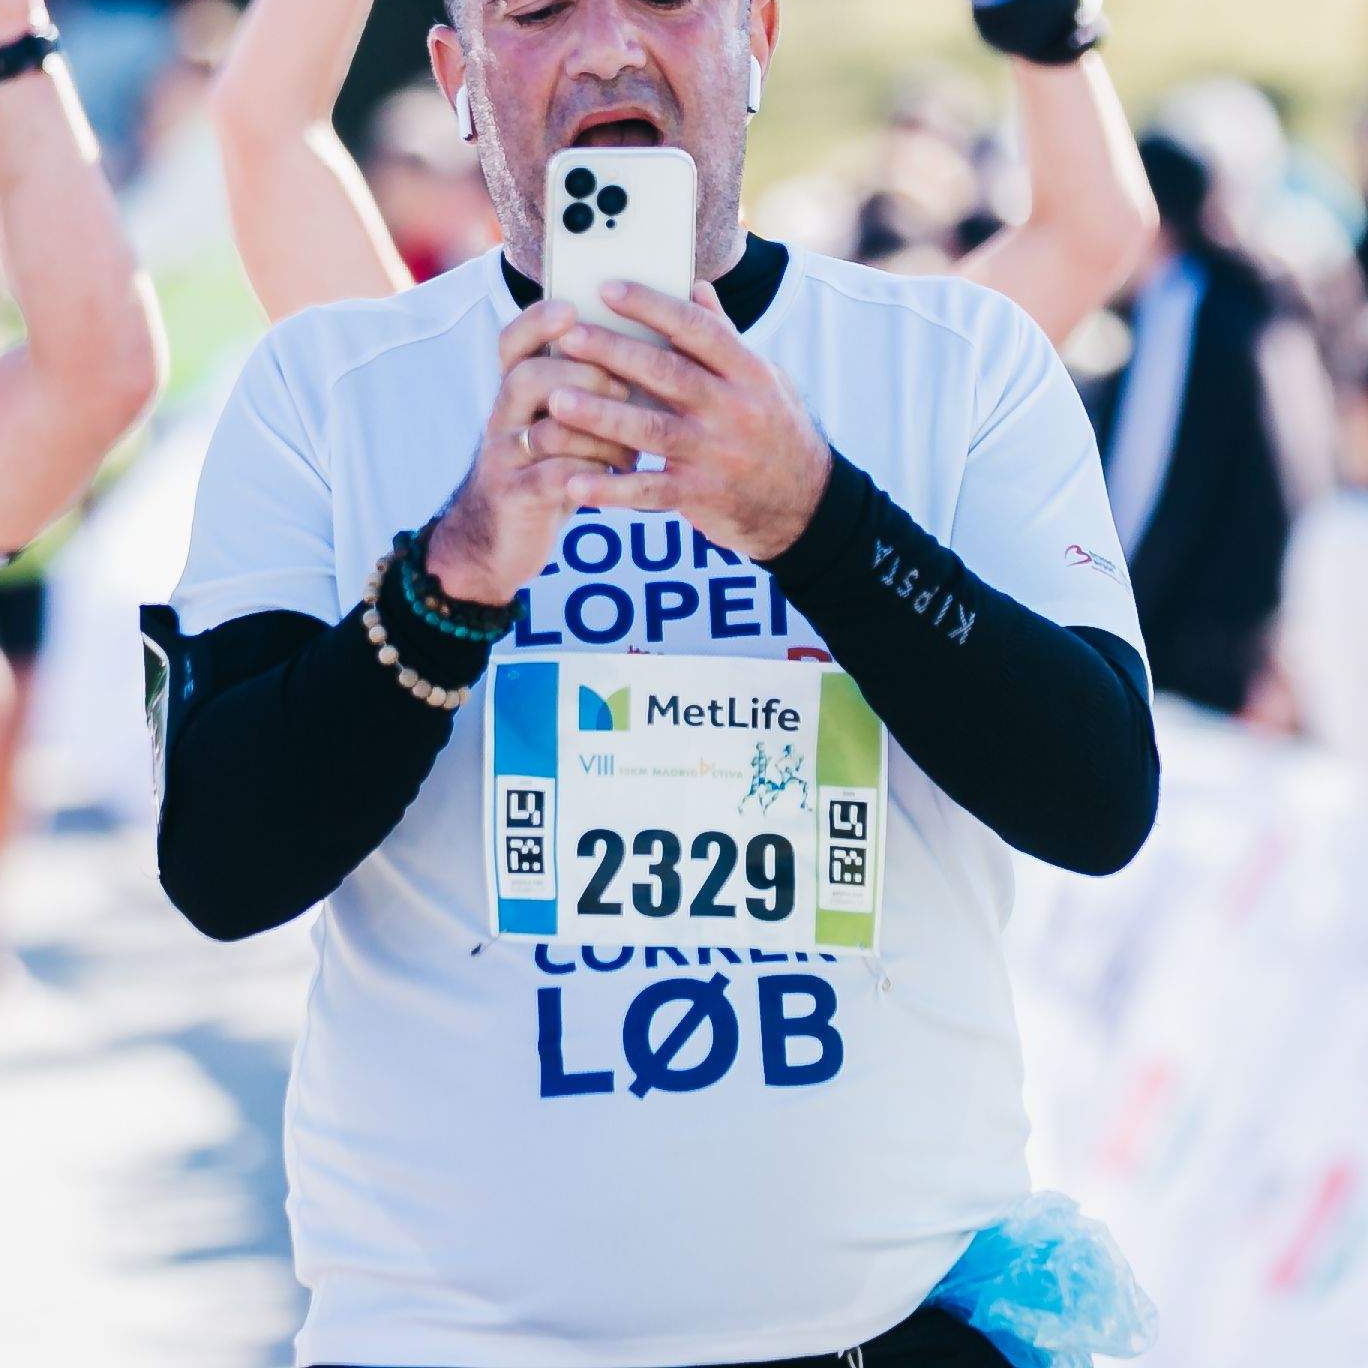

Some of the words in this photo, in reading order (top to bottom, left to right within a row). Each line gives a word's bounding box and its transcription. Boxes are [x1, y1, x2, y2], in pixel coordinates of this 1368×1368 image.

[872, 537, 977, 646] KIPSTA
[647, 695, 801, 732] MetLife
[578, 754, 615, 776] VIII
[576, 828, 797, 922] 2329
[537, 972, 844, 1099] LØB
